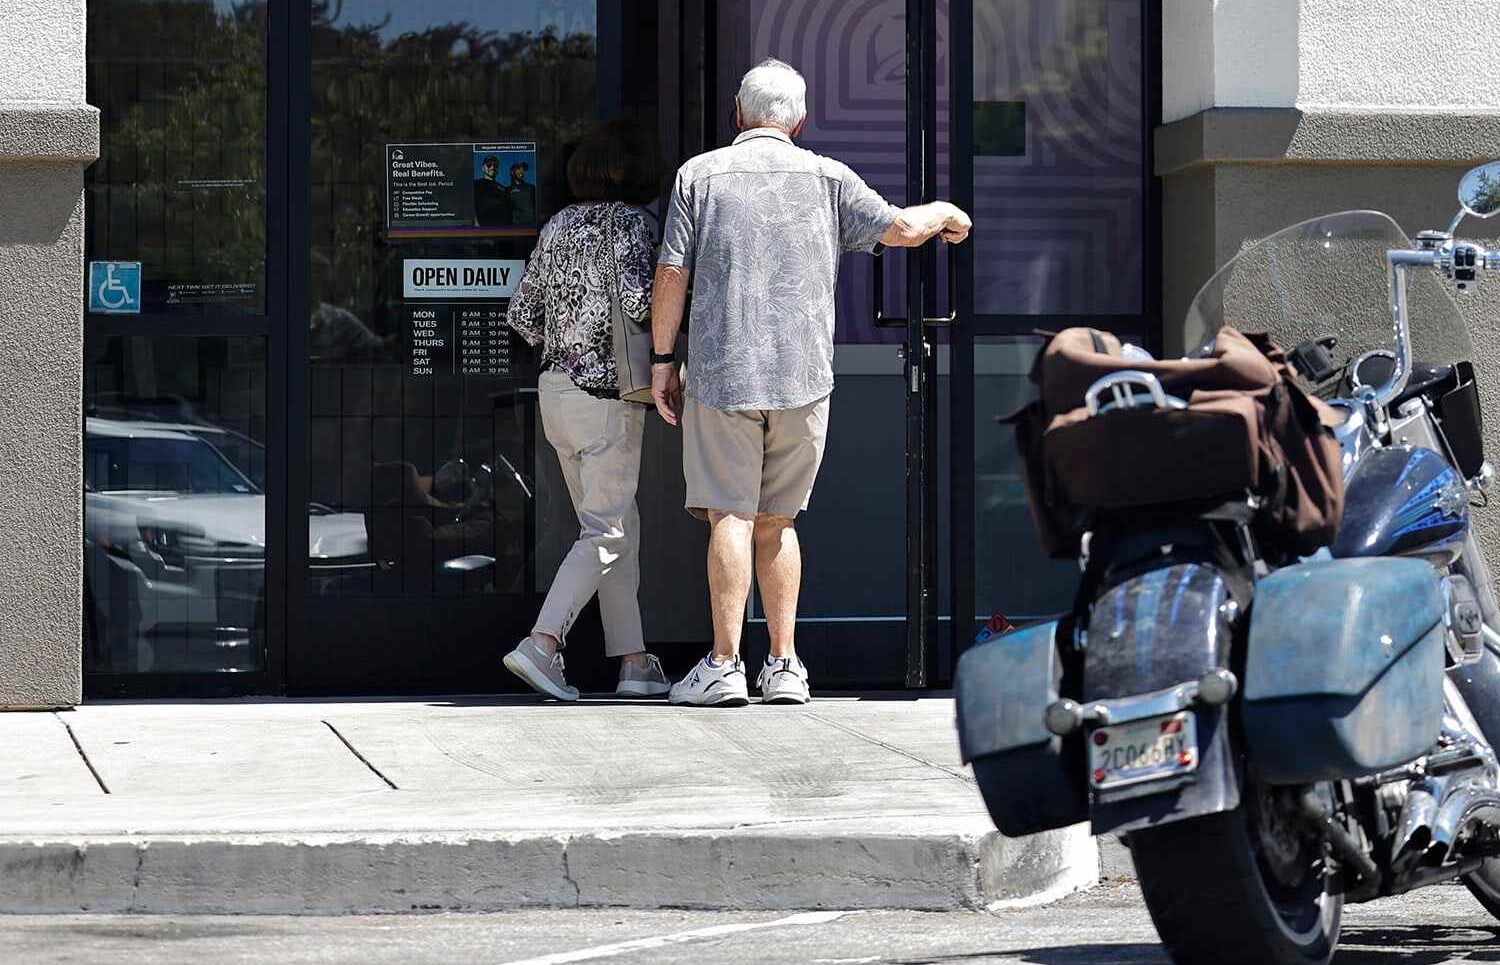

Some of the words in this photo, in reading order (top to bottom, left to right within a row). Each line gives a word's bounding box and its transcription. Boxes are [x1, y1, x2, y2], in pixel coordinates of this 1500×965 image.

[411, 169, 446, 177] Benefits.
[412, 267, 457, 287] OPEN
[463, 267, 511, 287] DAILY
[413, 311, 435, 319] MON
[488, 311, 497, 319] 10
[413, 320, 437, 328] TUES
[488, 320, 497, 328] 10
[497, 320, 509, 328] PM
[413, 329, 435, 337] WED
[488, 329, 497, 337] 10
[497, 329, 509, 337] PM
[413, 339, 444, 347] THURS
[488, 339, 497, 347] 10
[497, 339, 509, 347] PM
[413, 348, 428, 356] FRI
[488, 348, 497, 356] 10
[497, 348, 509, 356] PM
[413, 358, 431, 366] SAT
[488, 358, 497, 366] 10
[497, 358, 509, 366] PM
[413, 367, 433, 375] SUN
[488, 367, 497, 375] 10
[497, 367, 509, 375] PM
